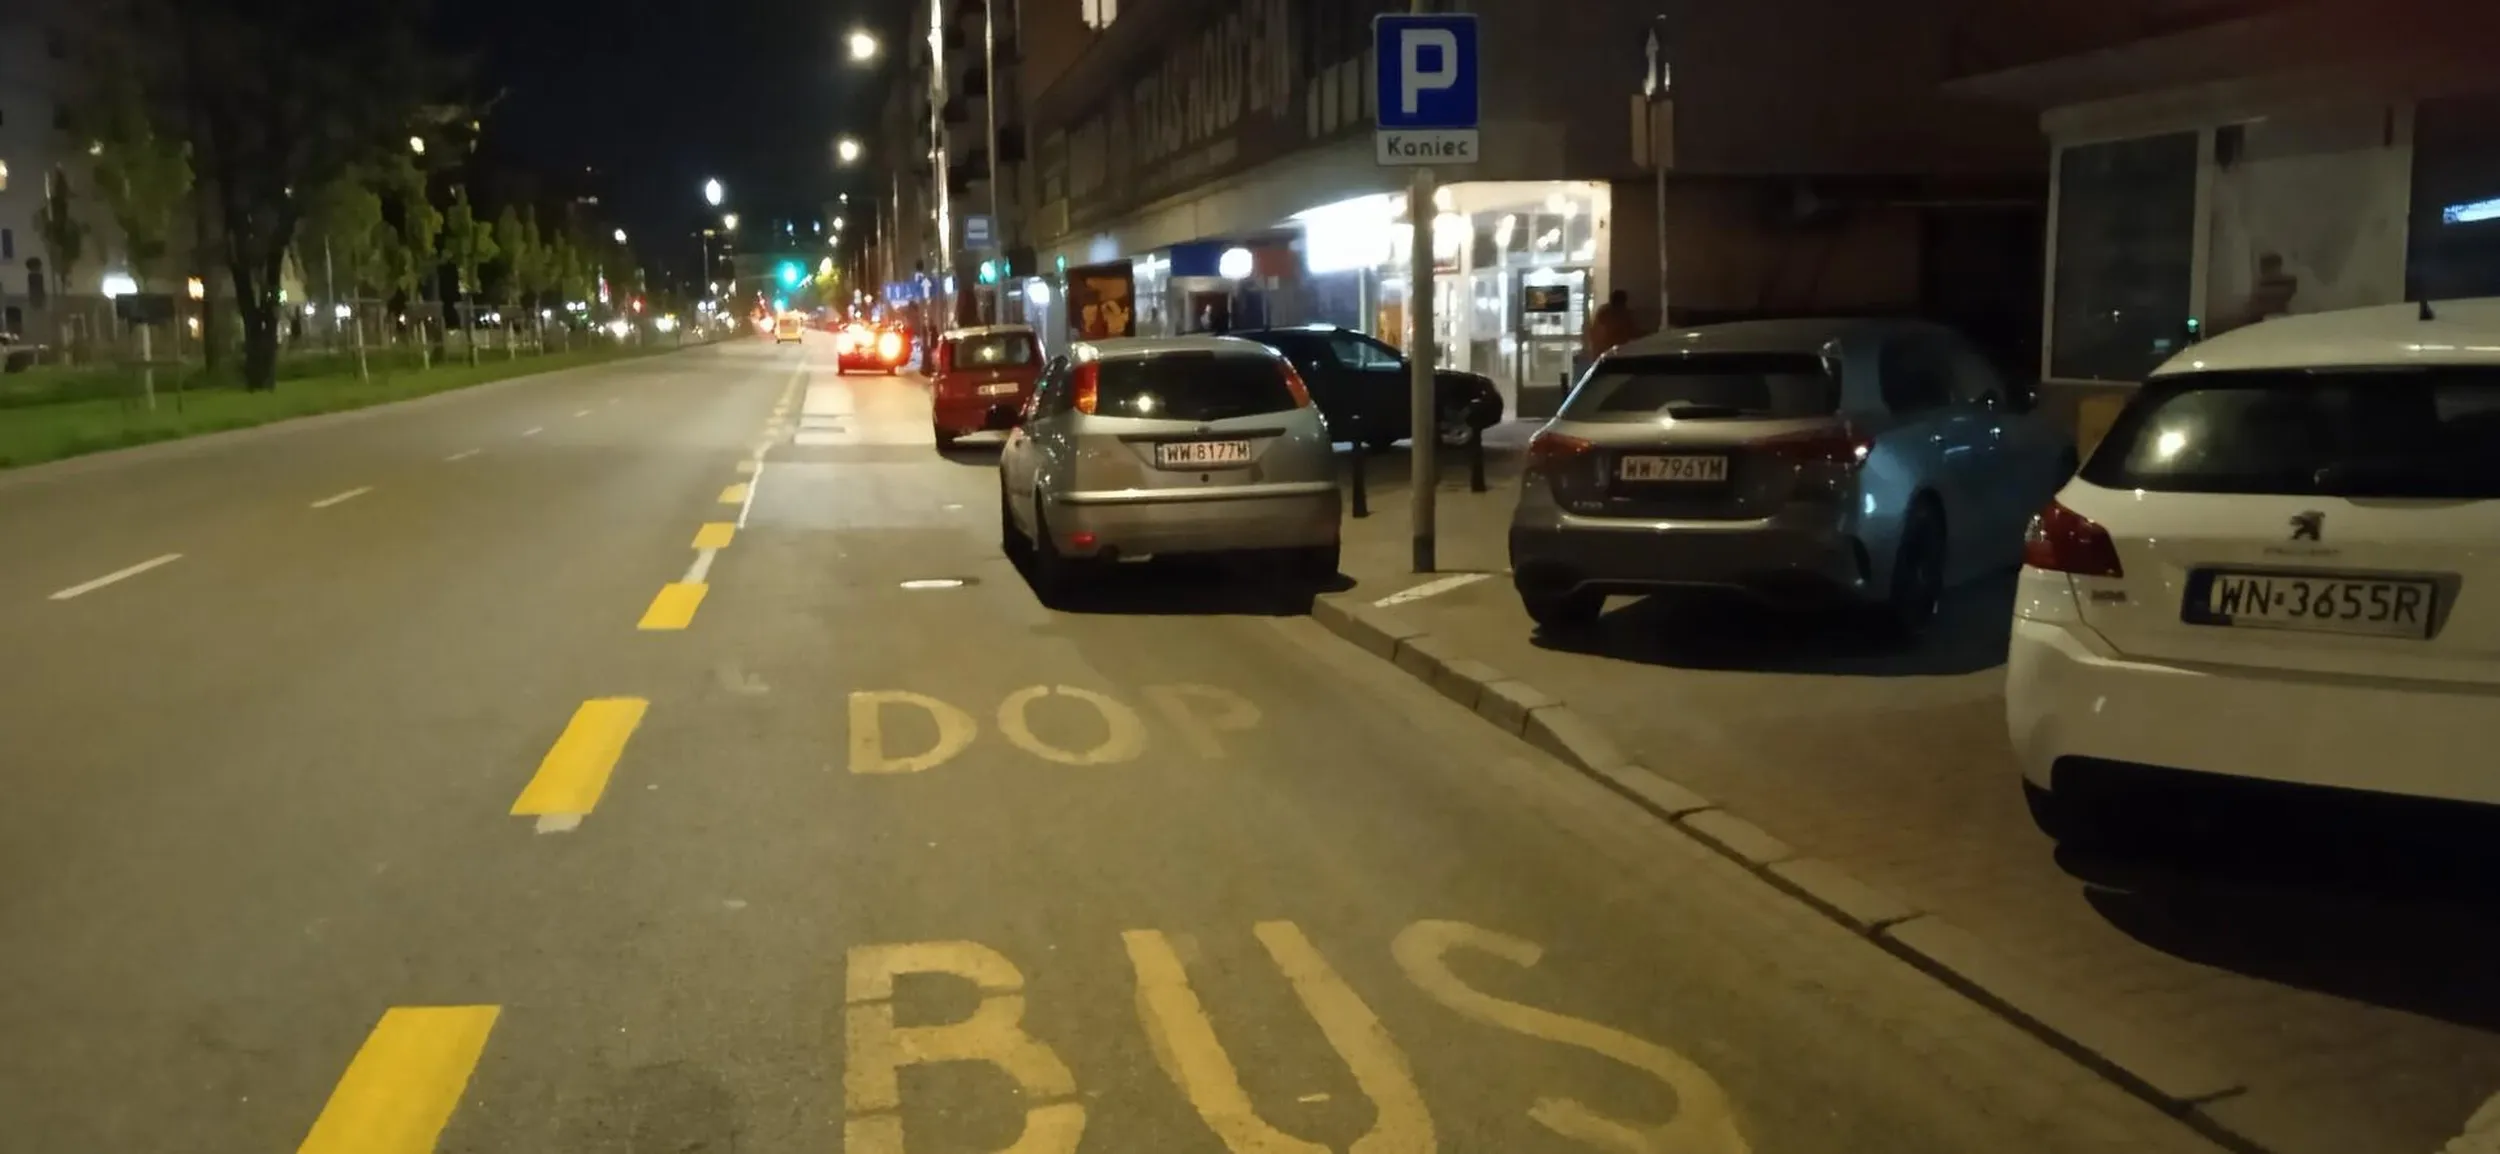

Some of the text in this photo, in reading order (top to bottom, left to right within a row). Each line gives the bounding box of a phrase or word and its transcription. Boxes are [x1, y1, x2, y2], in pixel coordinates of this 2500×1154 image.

[1401, 28, 1458, 114] P
[1387, 135, 1469, 157] Koniec
[1167, 445, 1191, 461] WW
[2219, 578, 2422, 625] WN 3655R
[848, 684, 1263, 775] DOP
[843, 920, 1754, 1154] BUS
